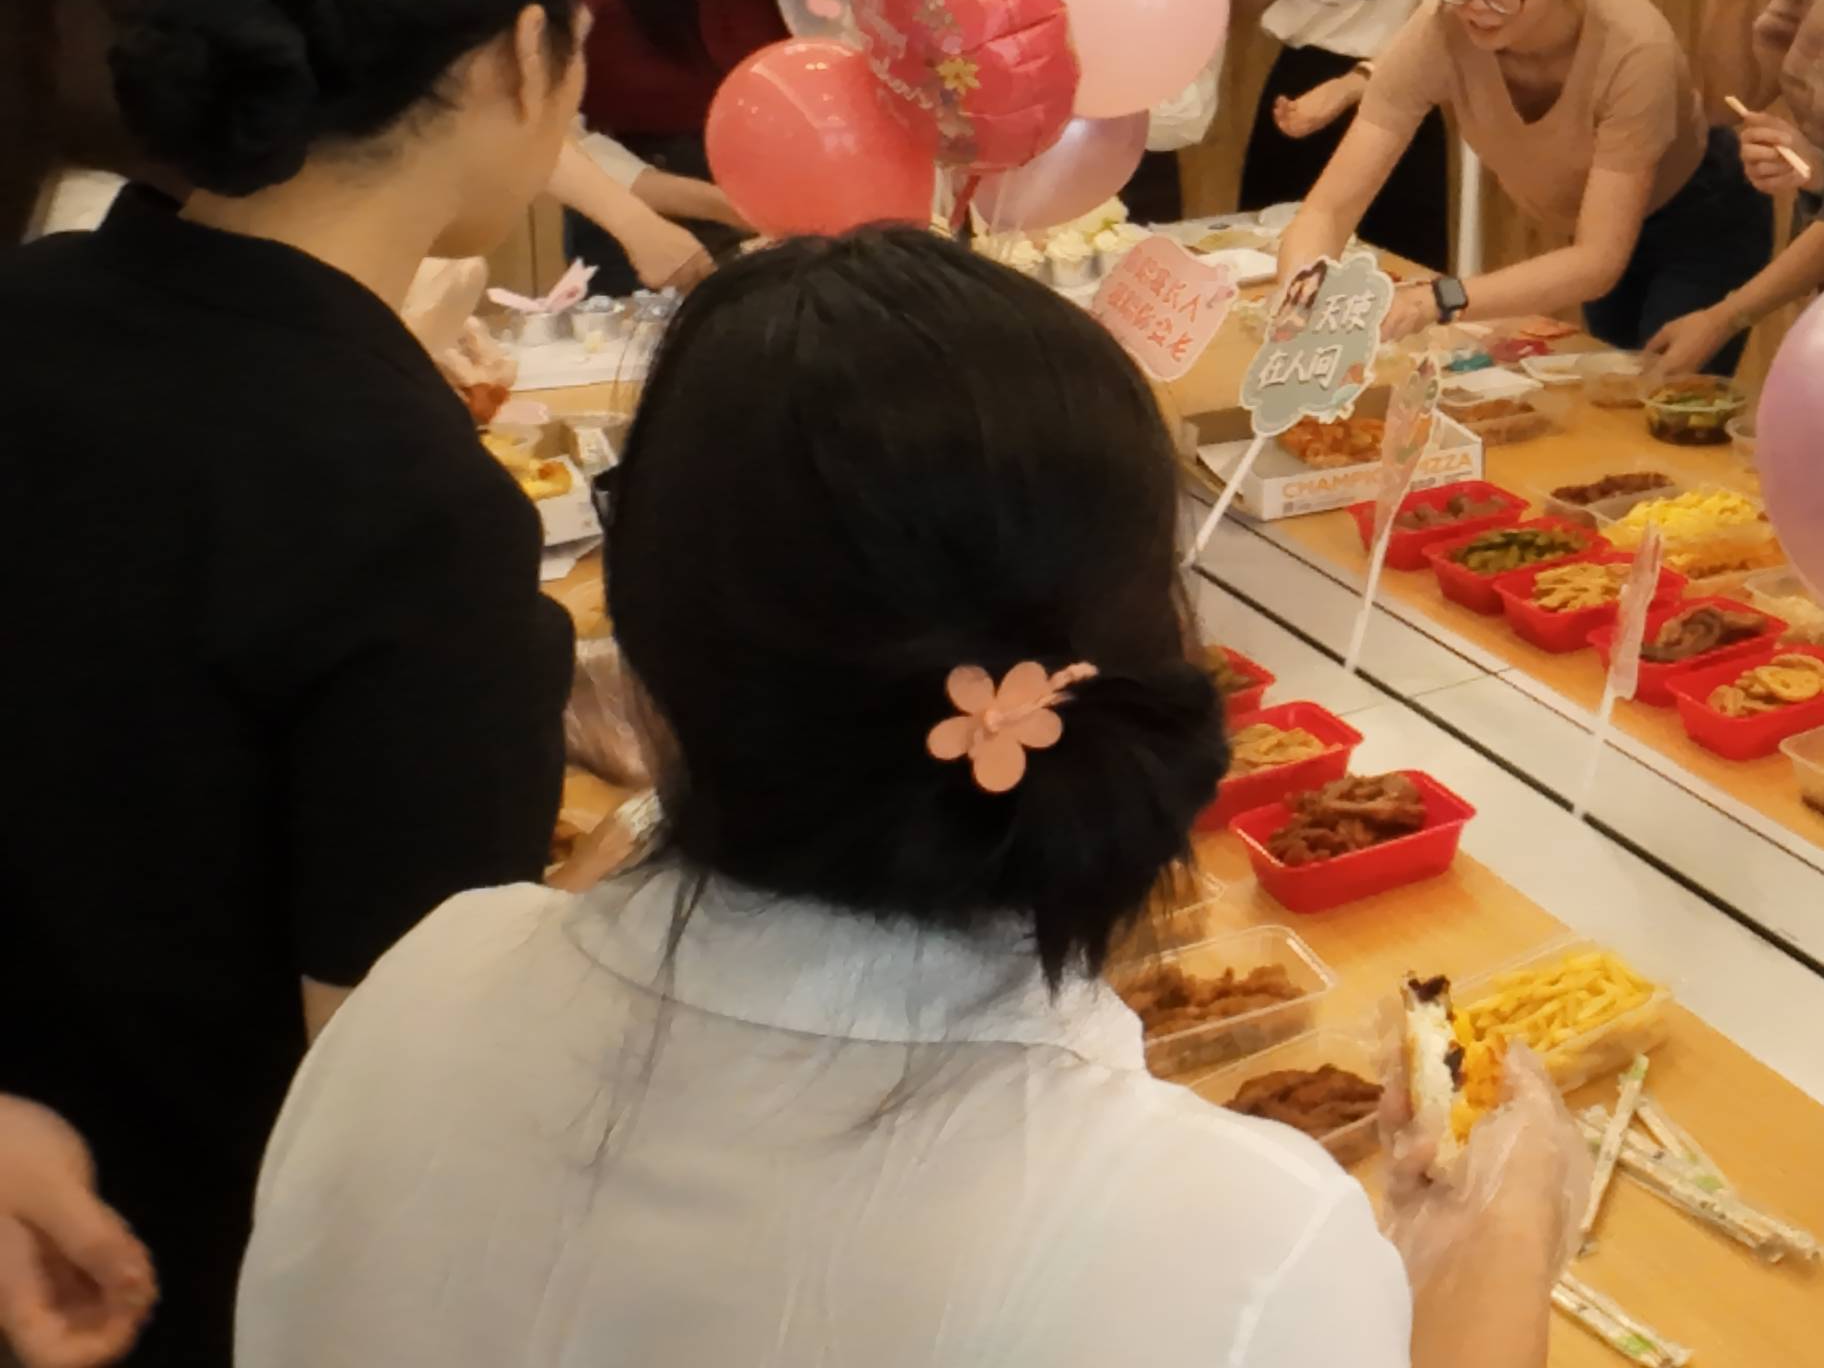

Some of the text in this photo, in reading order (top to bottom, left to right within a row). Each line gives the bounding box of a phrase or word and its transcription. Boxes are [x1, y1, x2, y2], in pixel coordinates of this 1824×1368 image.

[1311, 288, 1378, 334] 天使
[1255, 343, 1344, 392] 在人间
